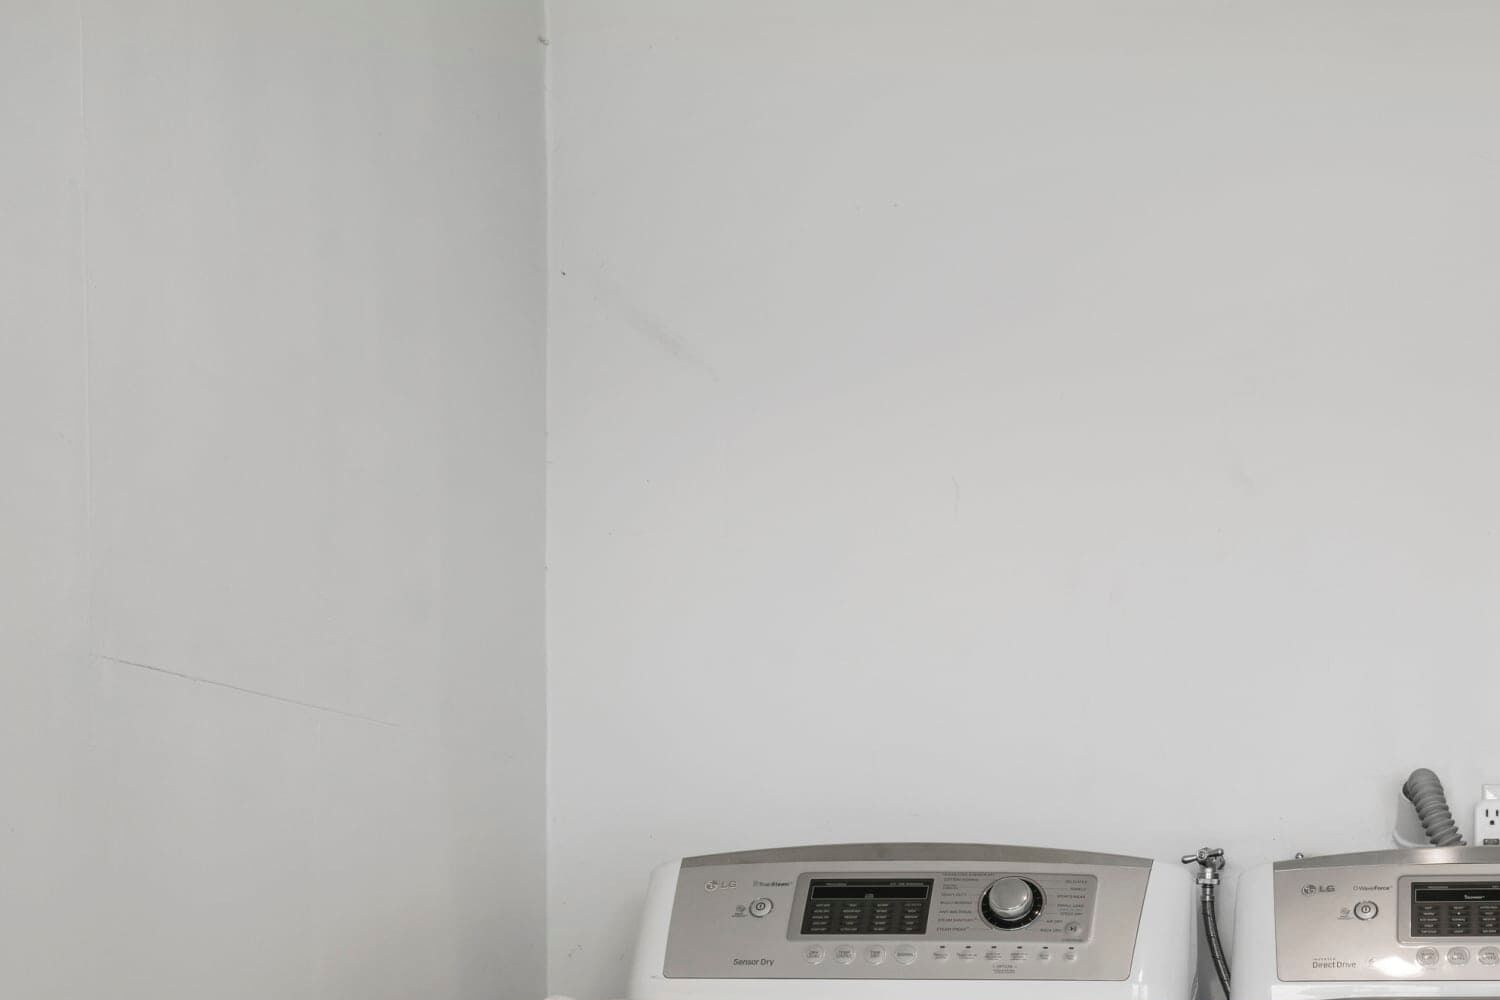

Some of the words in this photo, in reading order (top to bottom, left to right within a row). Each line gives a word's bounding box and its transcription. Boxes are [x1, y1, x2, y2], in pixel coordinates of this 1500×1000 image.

[720, 880, 737, 889] LG
[733, 958, 759, 966] Sensor
[760, 958, 775, 967] Dry
[1313, 961, 1335, 969] Direct
[1337, 961, 1357, 969] Drive
